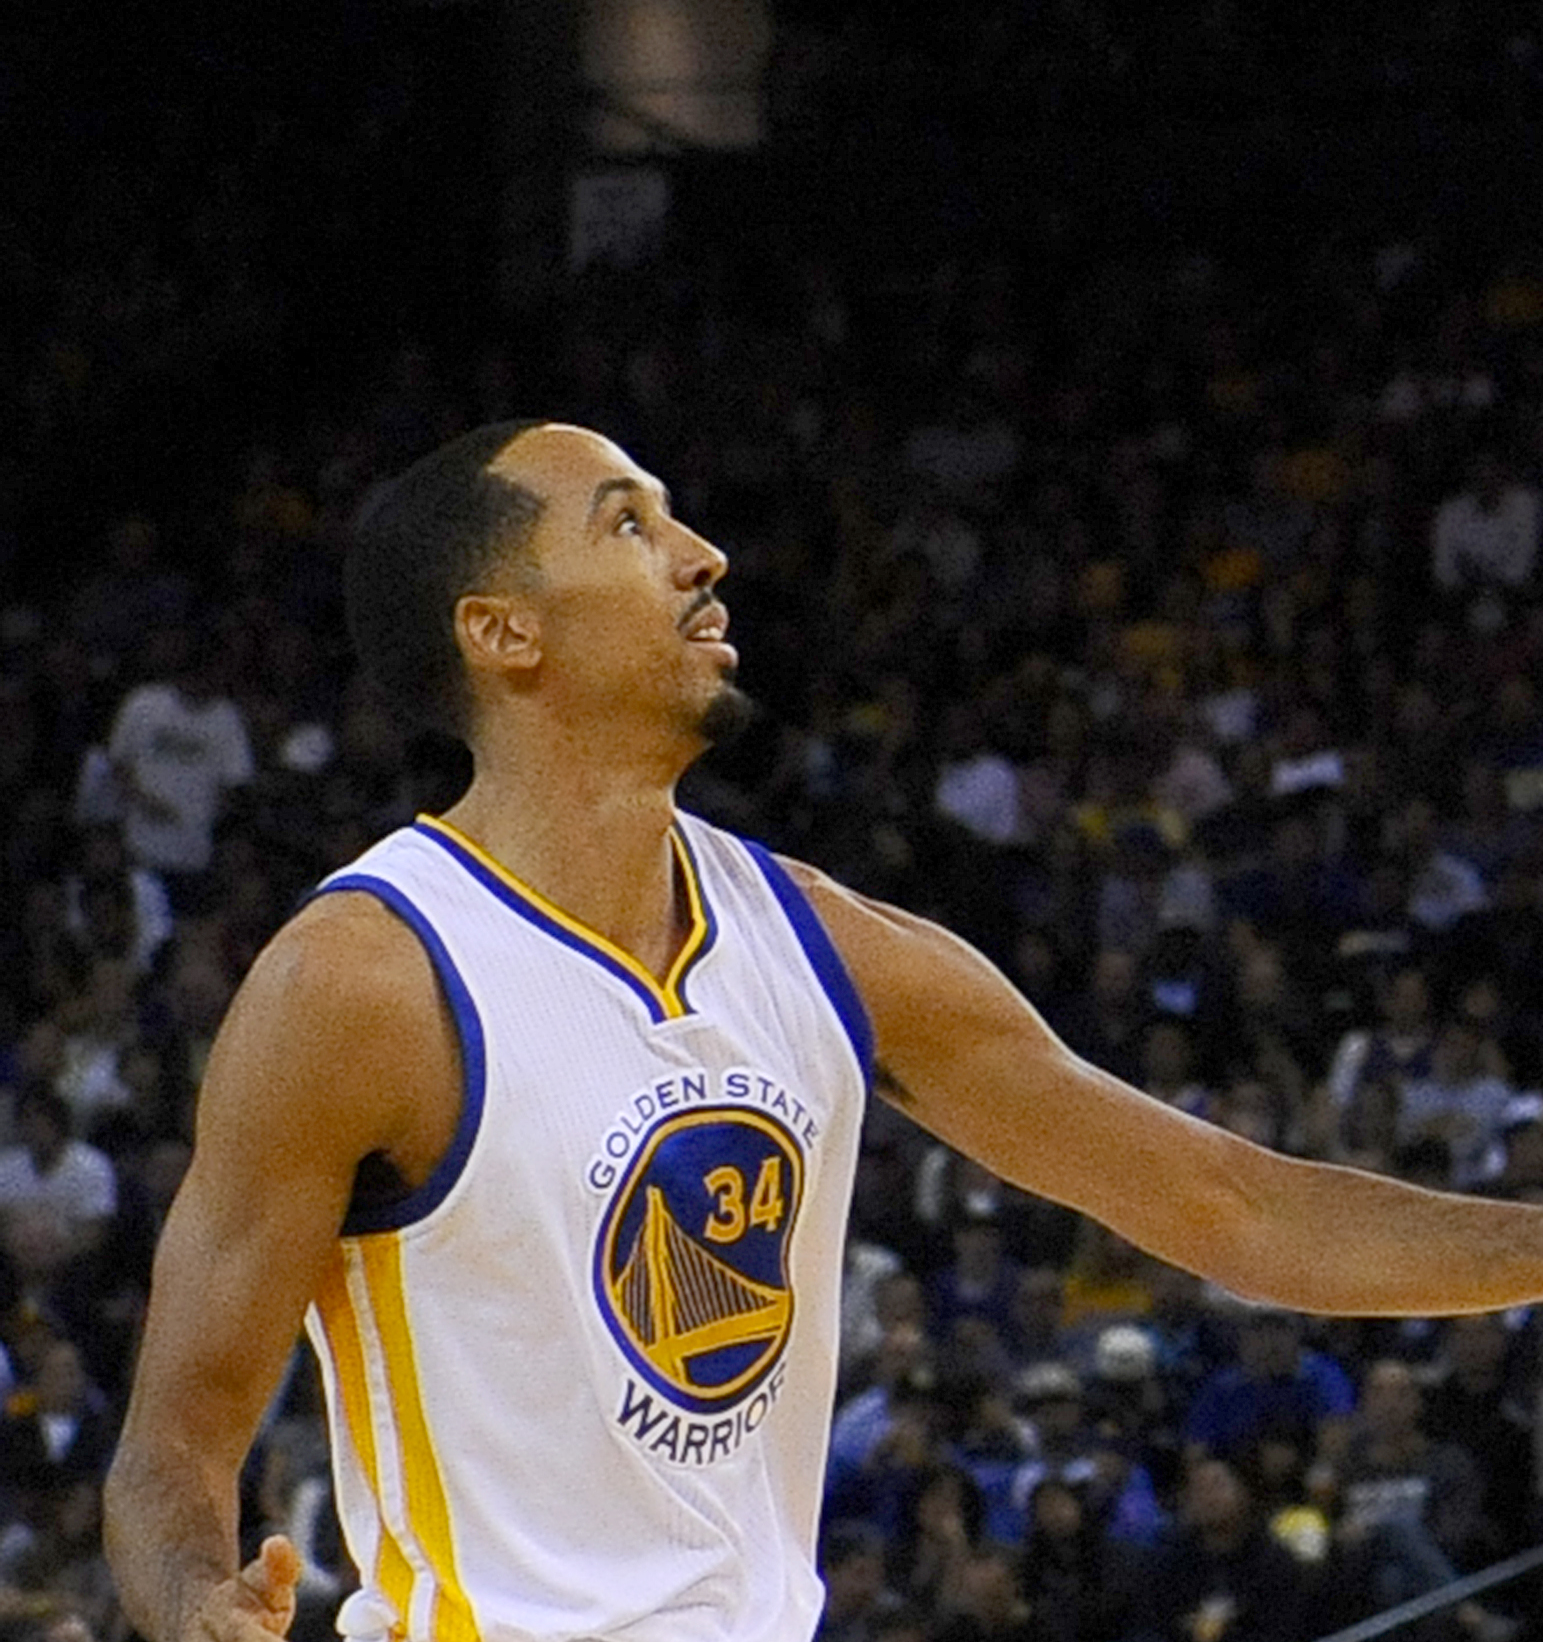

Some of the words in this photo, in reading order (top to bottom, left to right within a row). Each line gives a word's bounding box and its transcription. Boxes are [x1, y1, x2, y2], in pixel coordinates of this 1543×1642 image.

[589, 1073, 707, 1190] GOLDEN
[725, 1072, 820, 1150] STATE
[703, 1155, 785, 1244] 34
